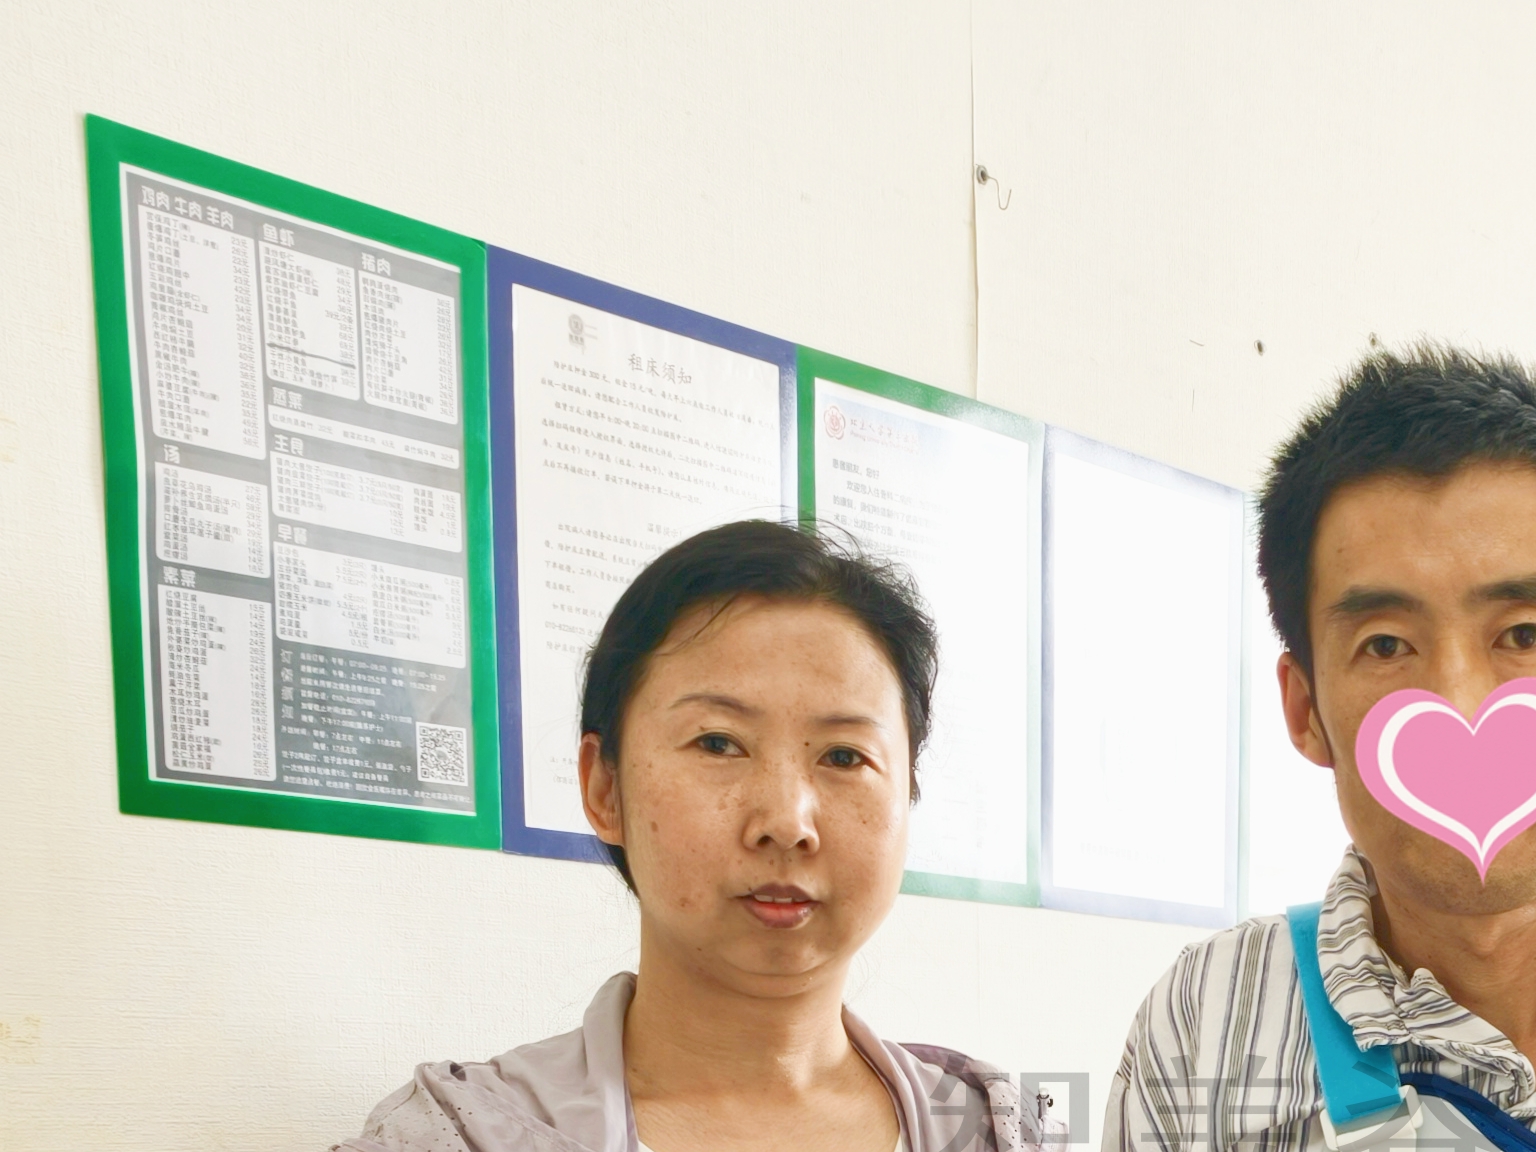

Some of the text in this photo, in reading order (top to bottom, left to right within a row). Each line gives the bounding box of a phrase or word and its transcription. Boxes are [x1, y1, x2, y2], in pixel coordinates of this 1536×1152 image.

[141, 185, 233, 230] 鸡肉 牛肉 羊肉
[262, 222, 295, 248] 鱼虾
[361, 251, 391, 277] 猪肉
[628, 353, 692, 385] 租床须知
